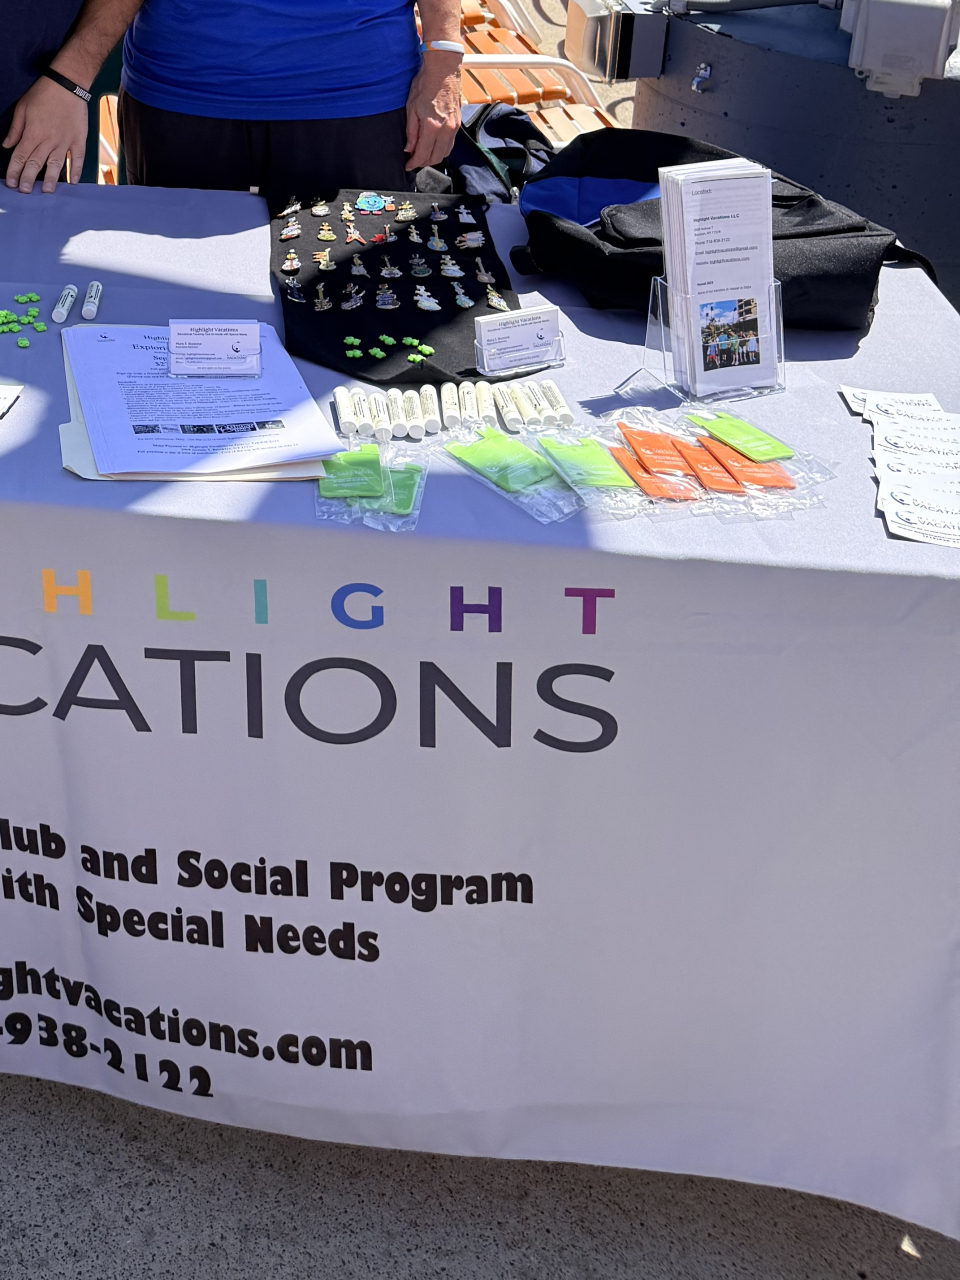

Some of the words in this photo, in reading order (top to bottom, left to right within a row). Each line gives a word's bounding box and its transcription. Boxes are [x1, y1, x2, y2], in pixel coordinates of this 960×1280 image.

[132, 343, 168, 351] Explori
[80, 845, 158, 885] and
[178, 850, 309, 898] Social
[330, 862, 534, 913] Program
[76, 886, 225, 949] Special
[245, 915, 380, 963] Needs
